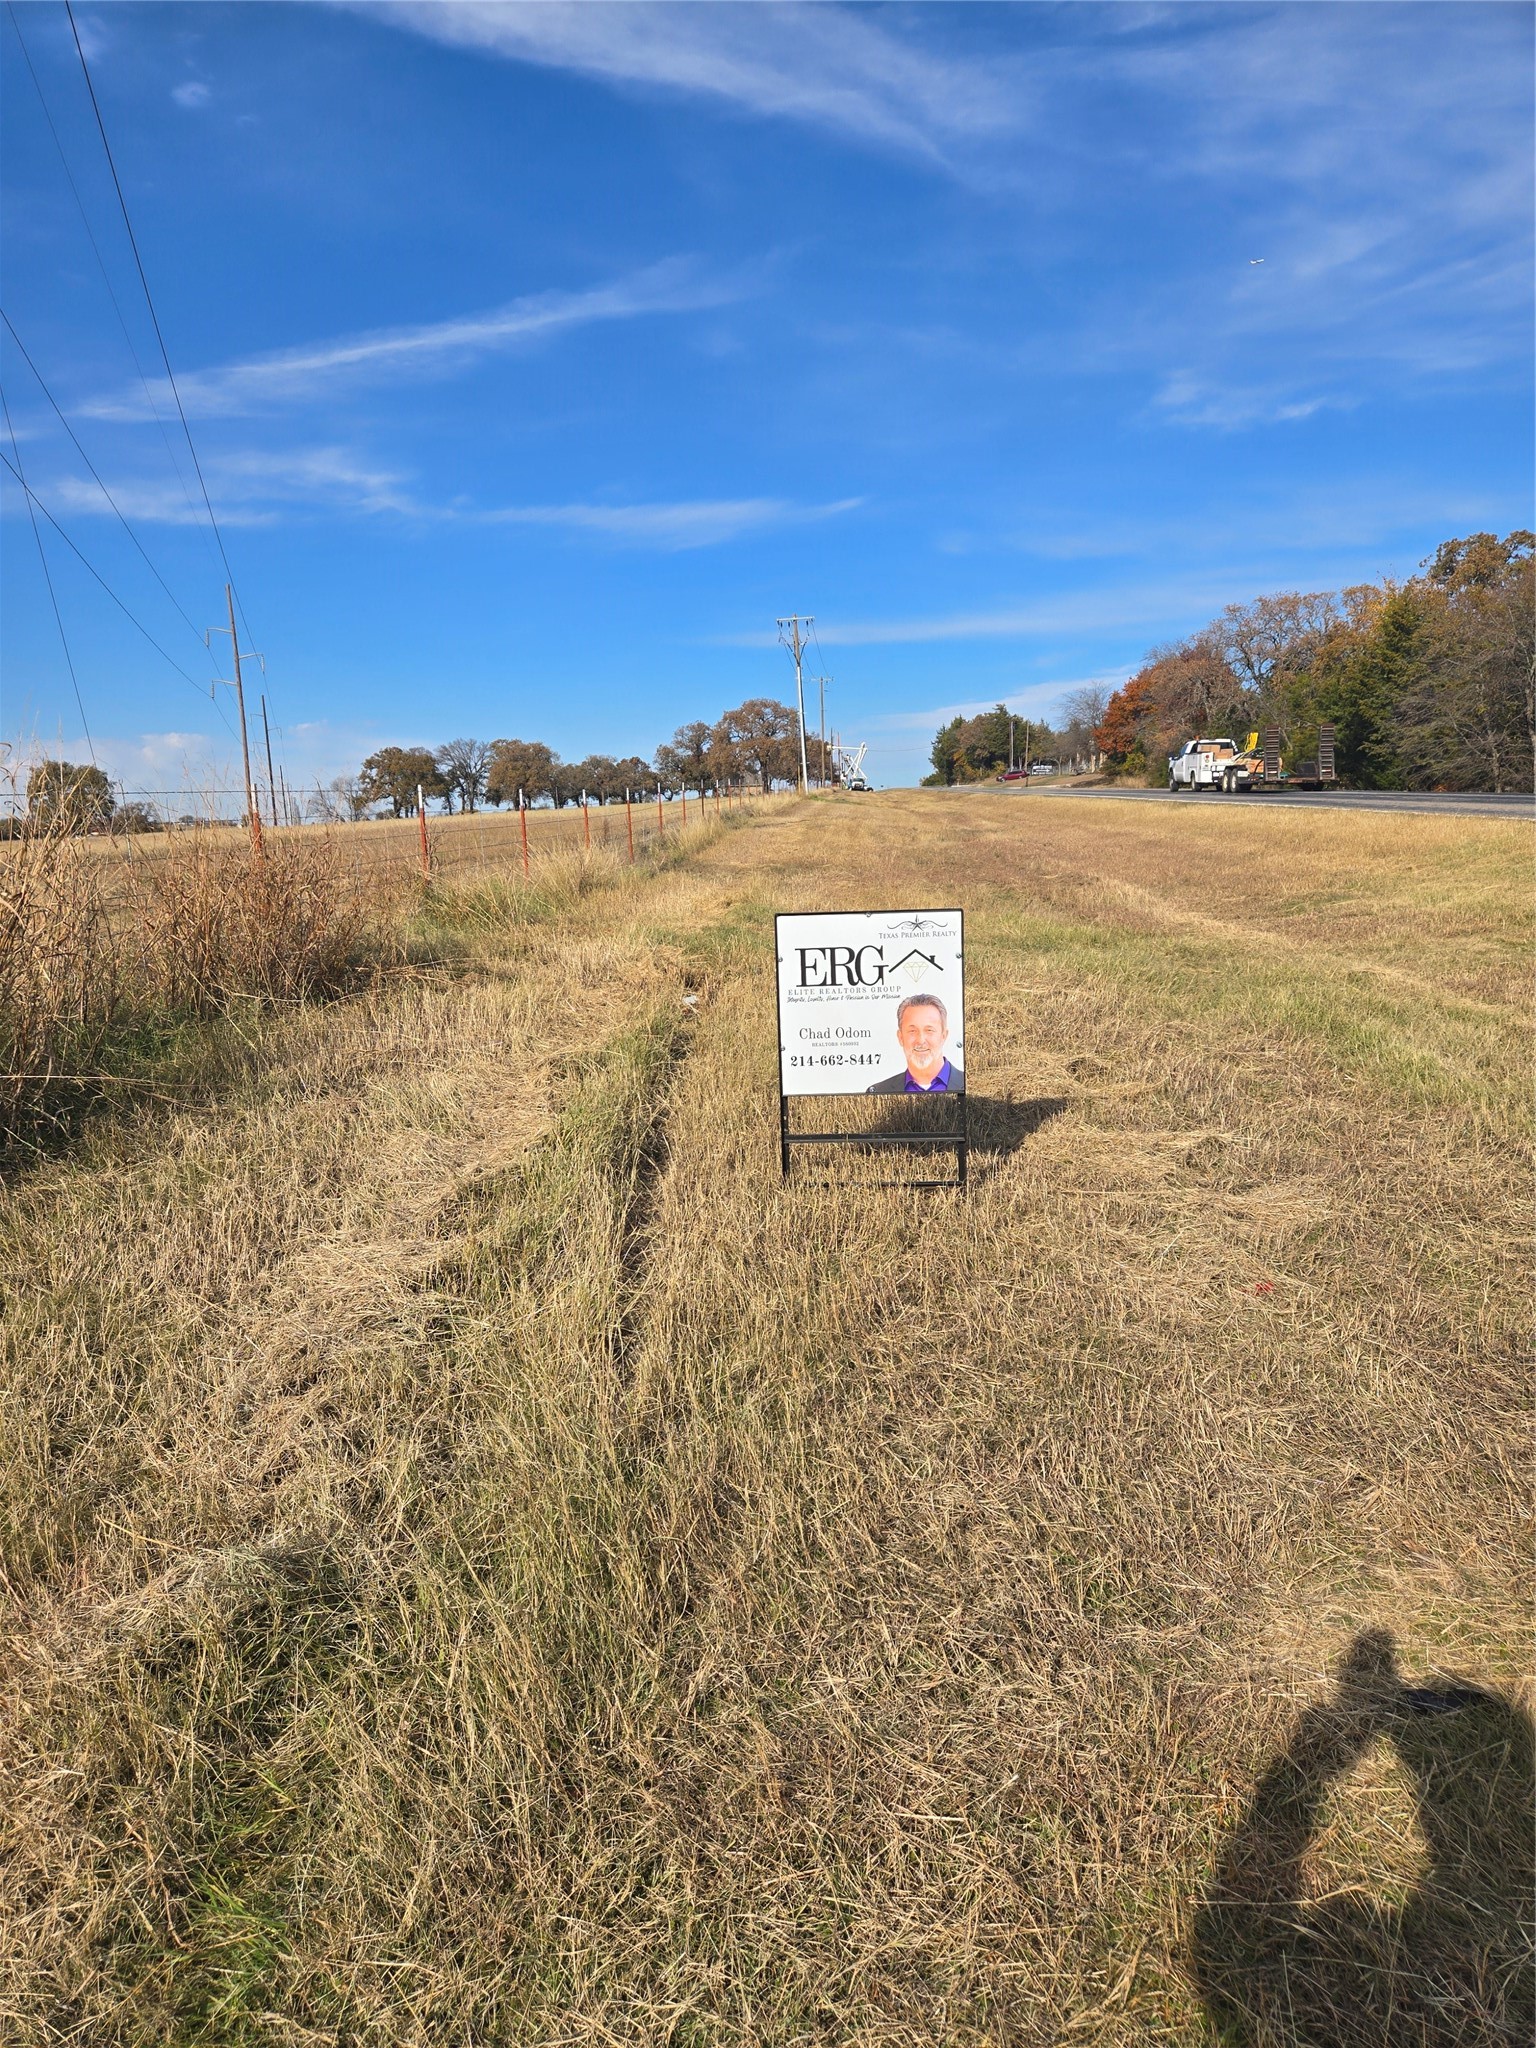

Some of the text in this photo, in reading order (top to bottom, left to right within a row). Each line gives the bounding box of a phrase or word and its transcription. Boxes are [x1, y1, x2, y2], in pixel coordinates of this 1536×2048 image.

[795, 945, 889, 987] ERG
[819, 987, 867, 995] REALTORS
[799, 1026, 871, 1039] Chad Odom
[790, 1053, 882, 1067] 214-662-8447
